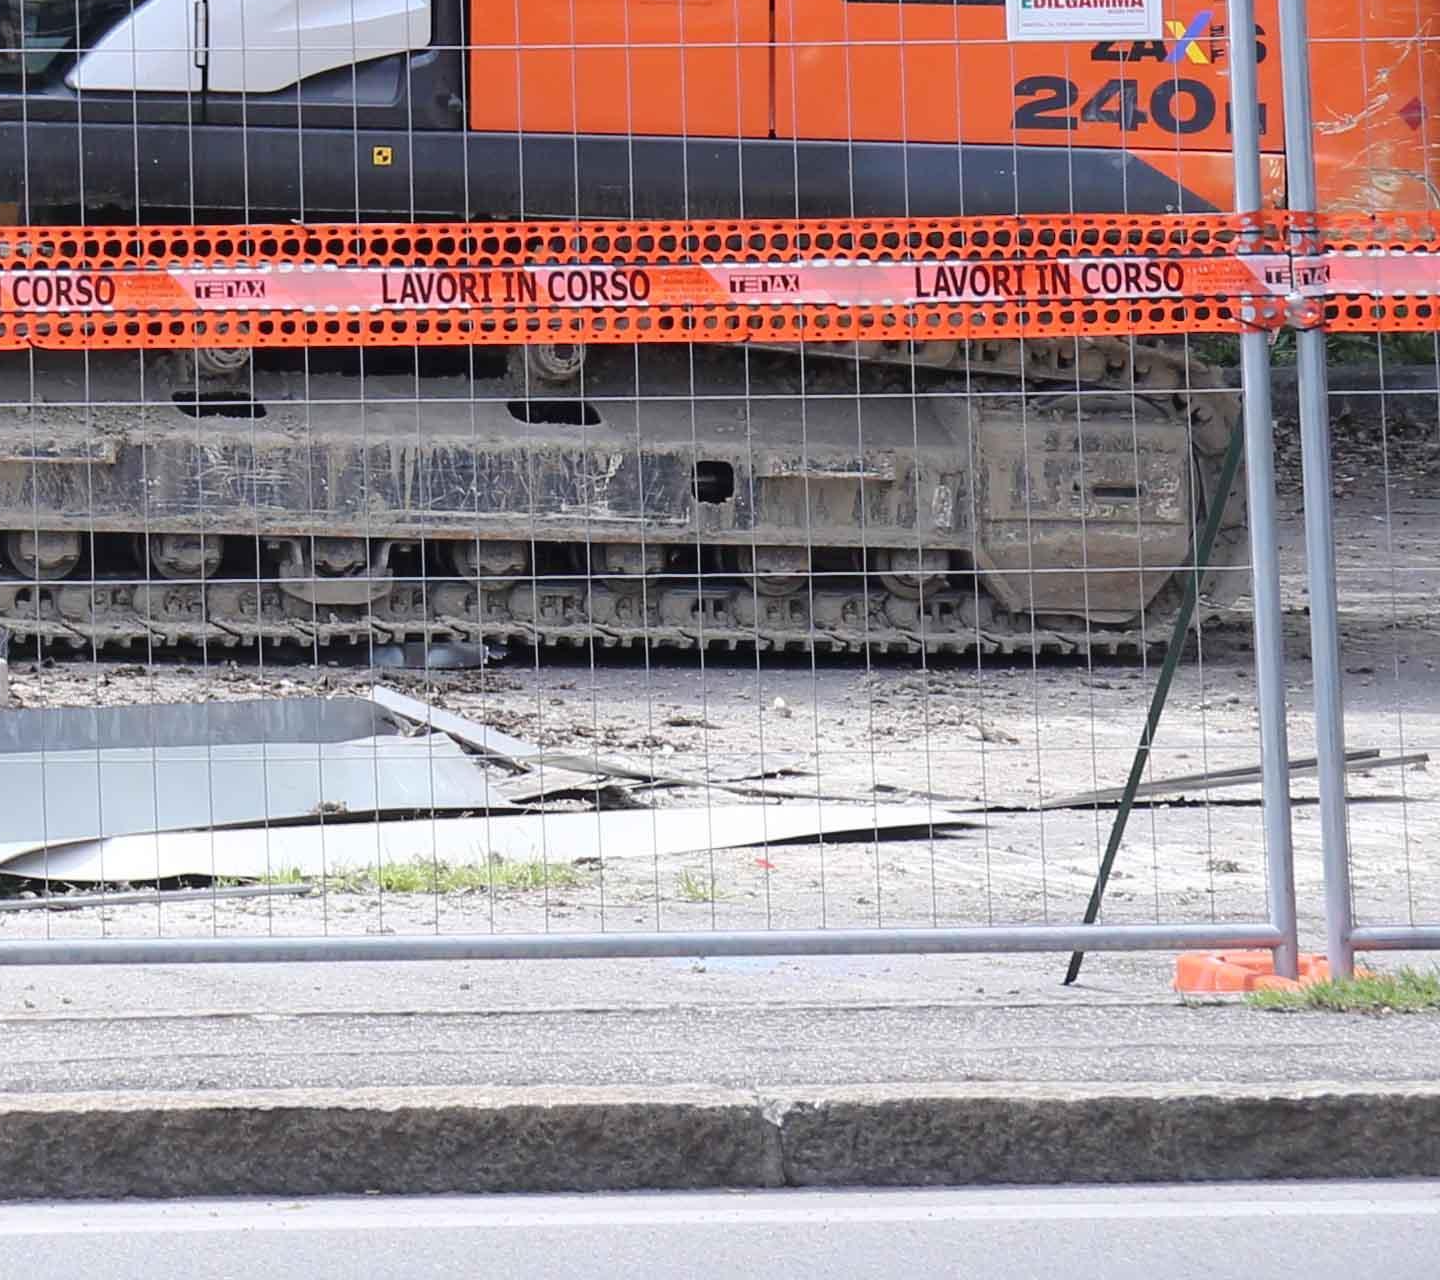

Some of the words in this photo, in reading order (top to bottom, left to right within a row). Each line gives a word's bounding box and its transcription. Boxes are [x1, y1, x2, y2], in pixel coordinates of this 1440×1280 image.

[12, 274, 116, 307] CORSO
[195, 279, 264, 299] TENAX
[382, 271, 494, 304] LAVORI
[502, 271, 537, 302] IN
[548, 269, 651, 301] CORSO
[730, 274, 799, 294] TENAX
[915, 265, 1028, 298] LAVORI
[1037, 264, 1072, 295] IN
[1081, 262, 1185, 293] CORSO
